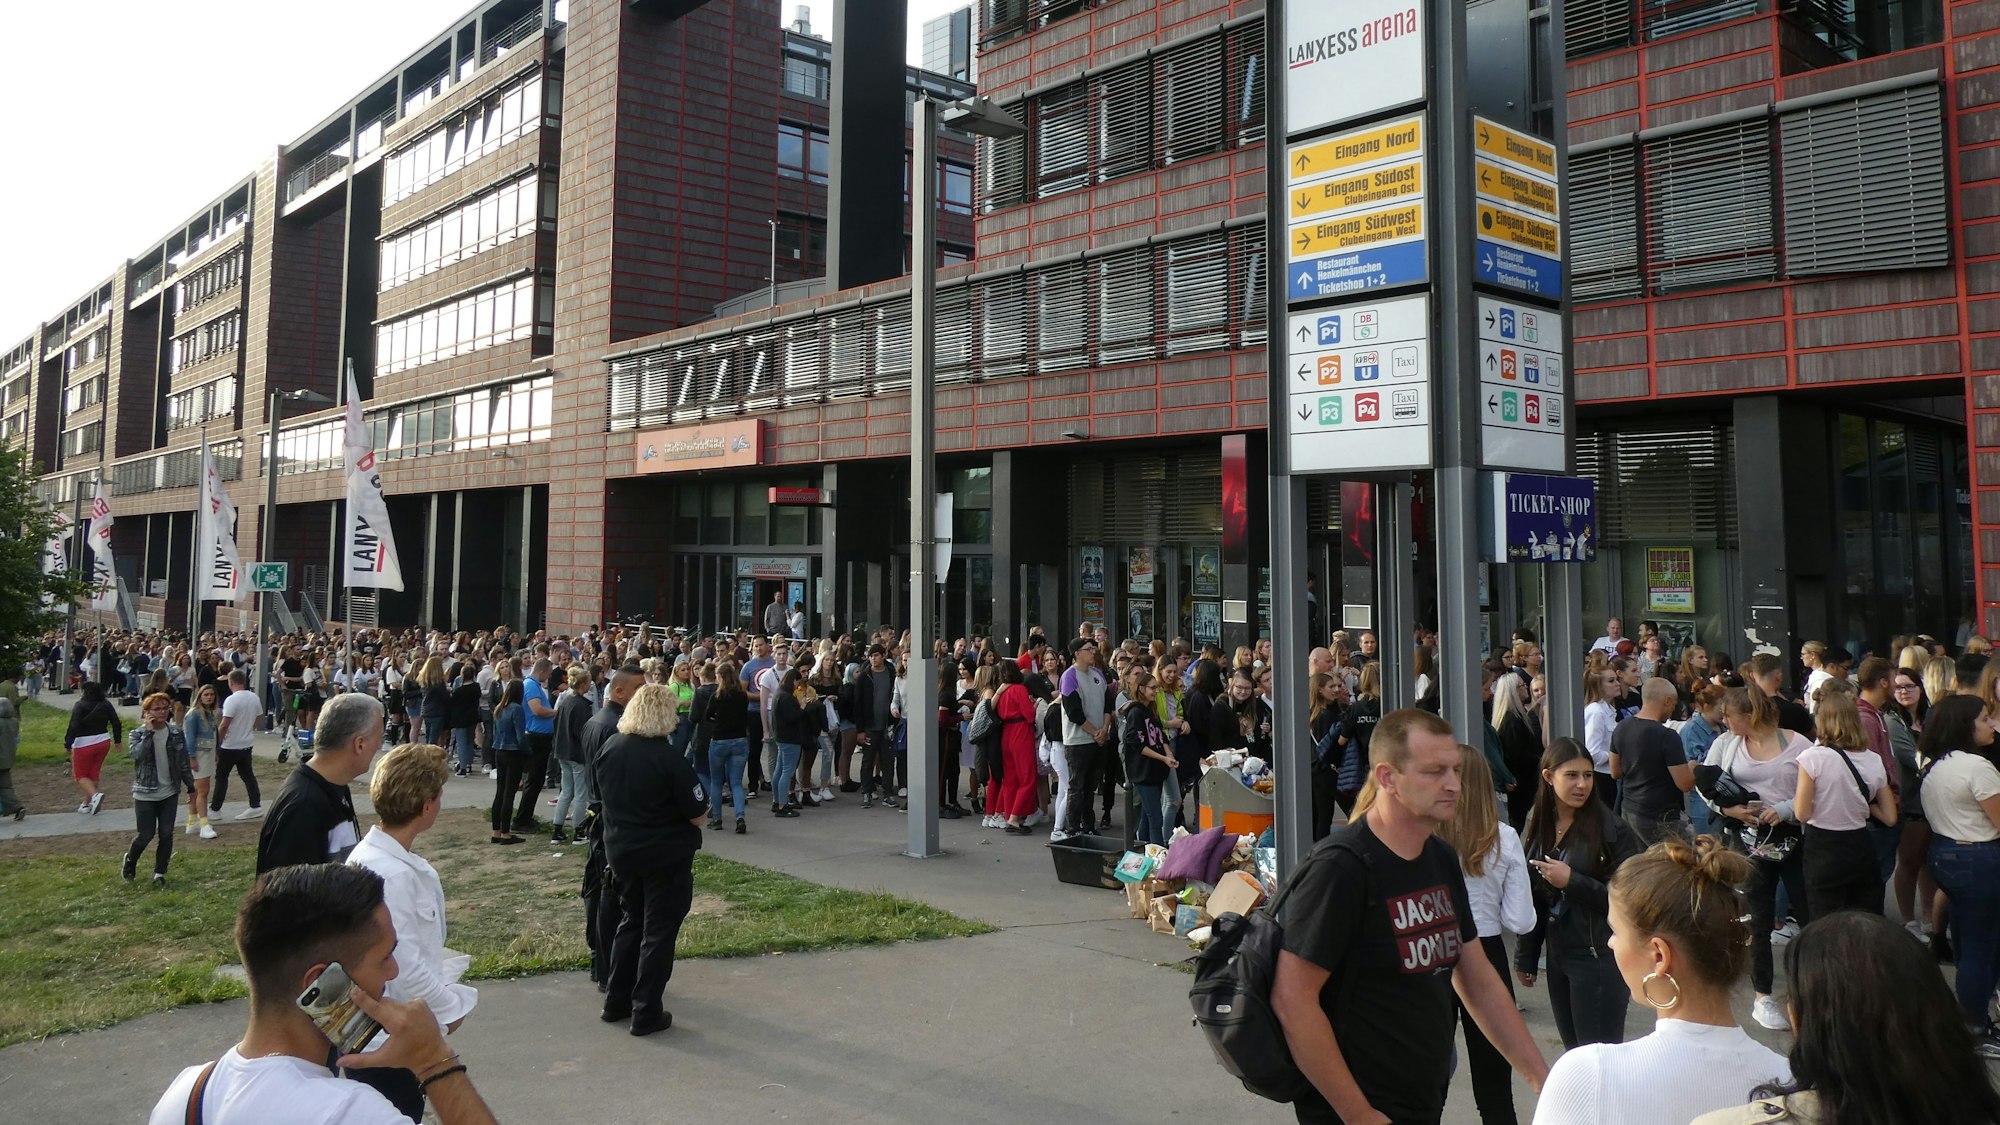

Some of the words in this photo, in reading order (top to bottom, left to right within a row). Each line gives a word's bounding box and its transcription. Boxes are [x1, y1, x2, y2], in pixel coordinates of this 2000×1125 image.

[1289, 28, 1358, 64] LANXESS
[1362, 8, 1417, 48] arena
[1335, 138, 1380, 160] Eingang
[1386, 128, 1415, 148] Nord
[1505, 137, 1534, 160] Eingang
[1536, 149, 1553, 166] Nord
[1325, 177, 1369, 198] Eingang
[1374, 166, 1415, 187] Südost
[1500, 171, 1529, 194] Eingang
[1531, 182, 1554, 201] Südost
[1344, 187, 1398, 206] Clubeingang
[1400, 183, 1415, 194] Ost
[1317, 219, 1361, 239] Eingang
[1366, 209, 1416, 231] Südwest
[1496, 210, 1525, 233] Eingang
[1527, 221, 1555, 241] Südwest
[1340, 230, 1393, 247] Clubeingang
[1396, 224, 1416, 236] West
[1317, 255, 1359, 271] Restaurant
[1317, 262, 1382, 281] Henkelmännchen
[1318, 277, 1364, 295] Ticketshop
[1360, 314, 1372, 324] DB
[1321, 326, 1337, 341] P1
[1502, 321, 1514, 334] P1
[1394, 356, 1416, 368] Taxi
[1502, 361, 1515, 375] P2
[1320, 366, 1338, 381] P2
[1361, 367, 1372, 379] U
[1527, 368, 1536, 381] U
[1394, 392, 1416, 403] Taxi
[1321, 407, 1339, 421] P3
[1357, 403, 1376, 418] P4
[1503, 403, 1516, 417] P3
[1526, 406, 1538, 420] P4
[1509, 492, 1591, 516] TICKET-SHOP
